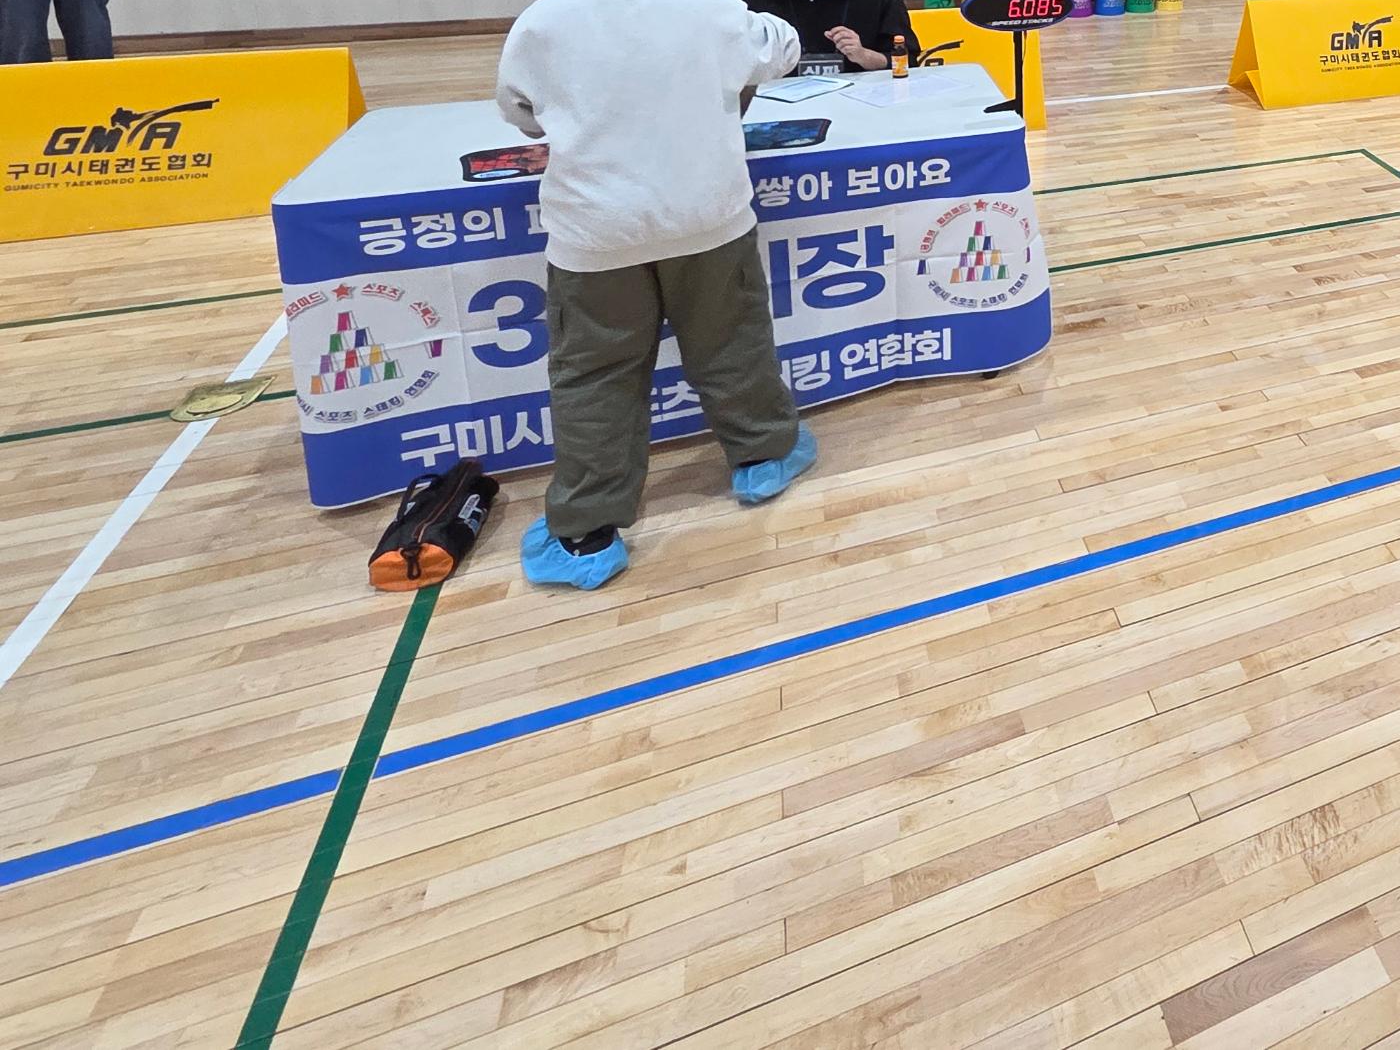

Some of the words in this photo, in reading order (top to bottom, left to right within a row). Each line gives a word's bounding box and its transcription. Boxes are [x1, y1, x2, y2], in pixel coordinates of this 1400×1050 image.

[1320, 50, 1400, 65] 구미시태권도협회
[4, 182, 59, 192] GUMICITY
[65, 177, 135, 188] TAEKWONDO
[140, 172, 209, 183] ASSOCIATION
[7, 153, 212, 180] 구미시태권도협회
[754, 171, 832, 207] 쌓아
[846, 158, 950, 196] 보아요
[359, 207, 506, 256] 긍정의
[468, 280, 550, 368] 3
[840, 328, 952, 381] 연합회
[400, 407, 555, 468] 구미시
